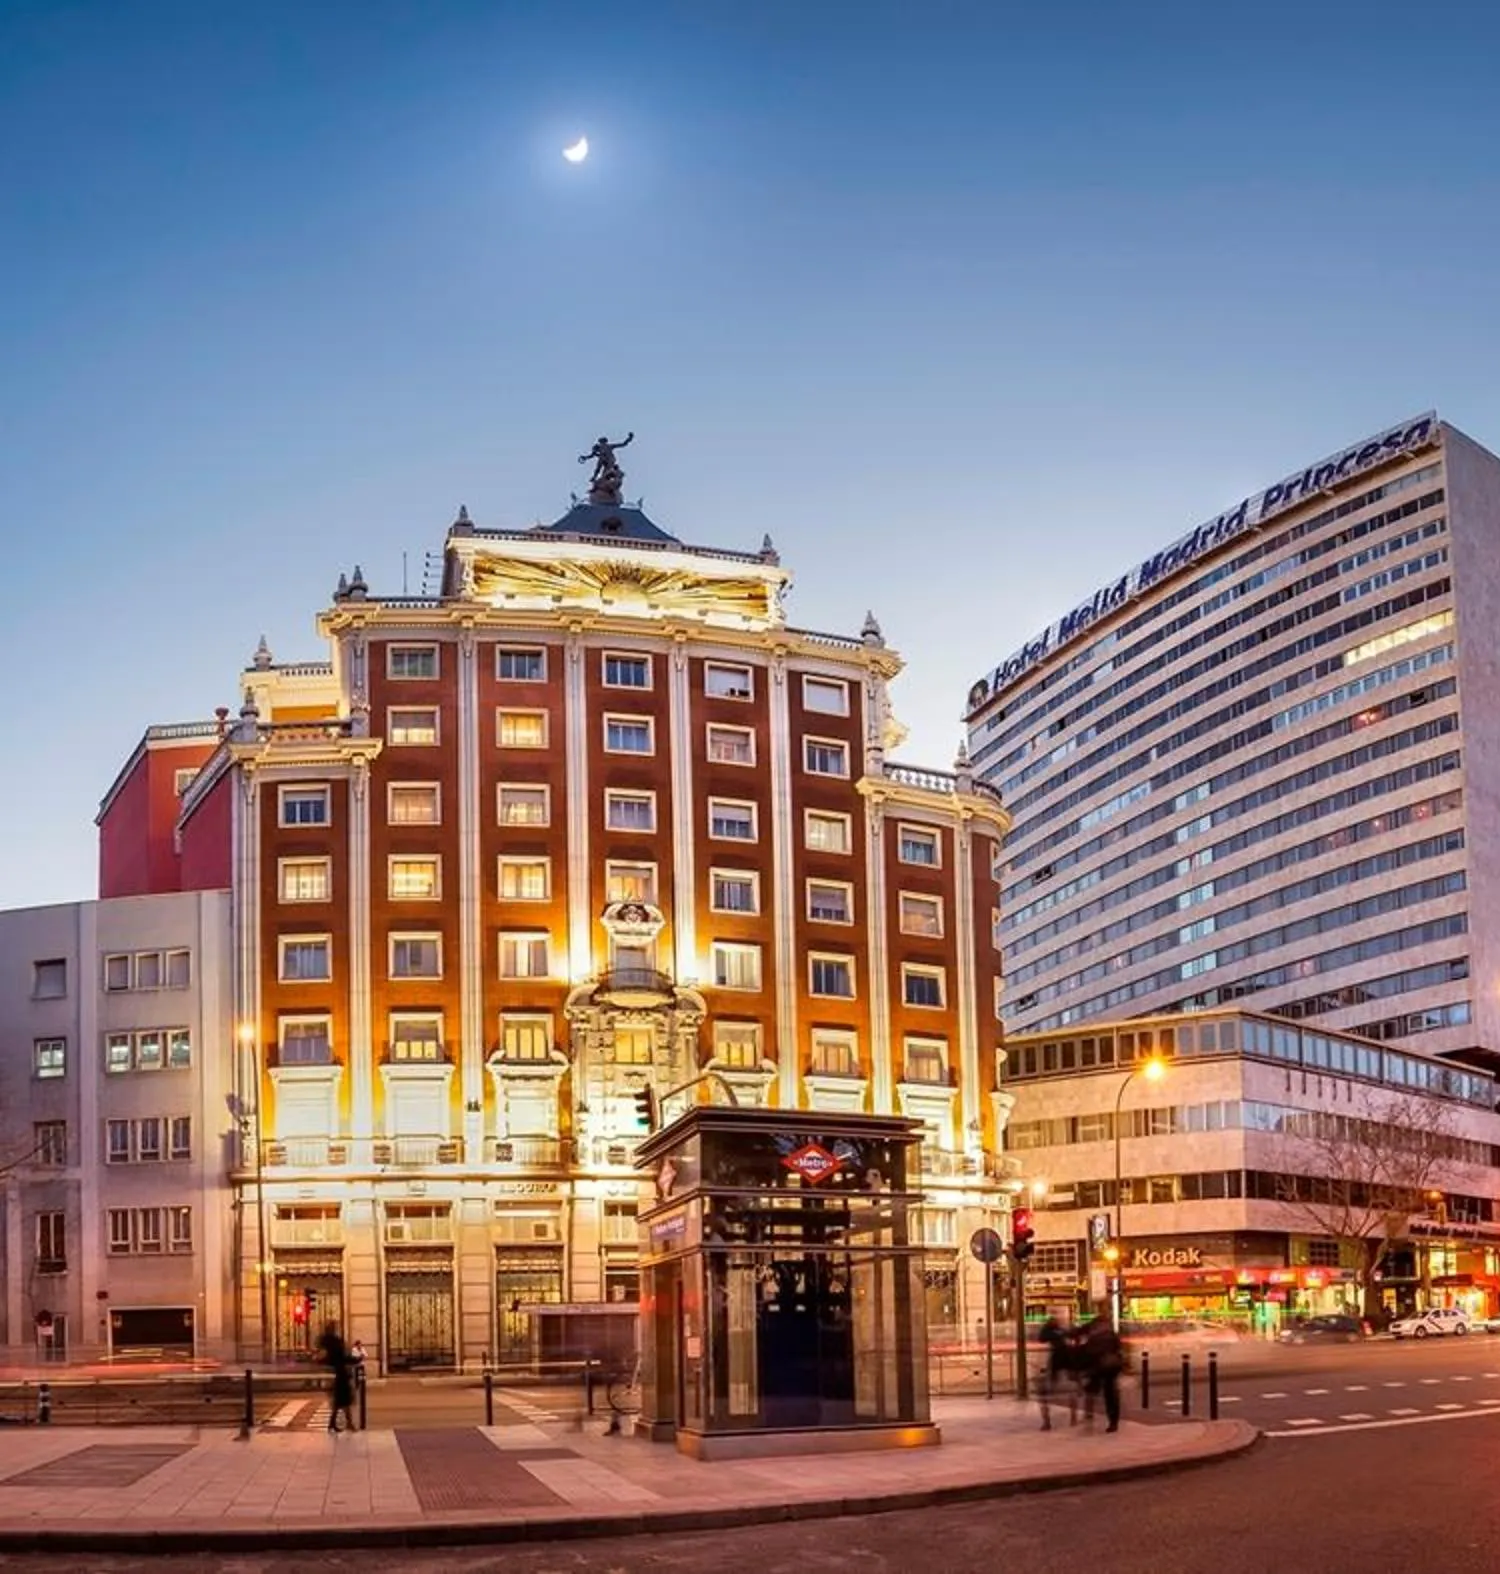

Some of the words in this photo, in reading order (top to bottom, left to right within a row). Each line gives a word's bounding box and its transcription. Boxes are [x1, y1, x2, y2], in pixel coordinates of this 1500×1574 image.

[993, 627, 1051, 690] Hotel
[1137, 498, 1250, 591] Madrid
[1259, 417, 1431, 518] Princesa
[799, 1156, 829, 1170] Metro
[1134, 1246, 1201, 1266] Kodak
